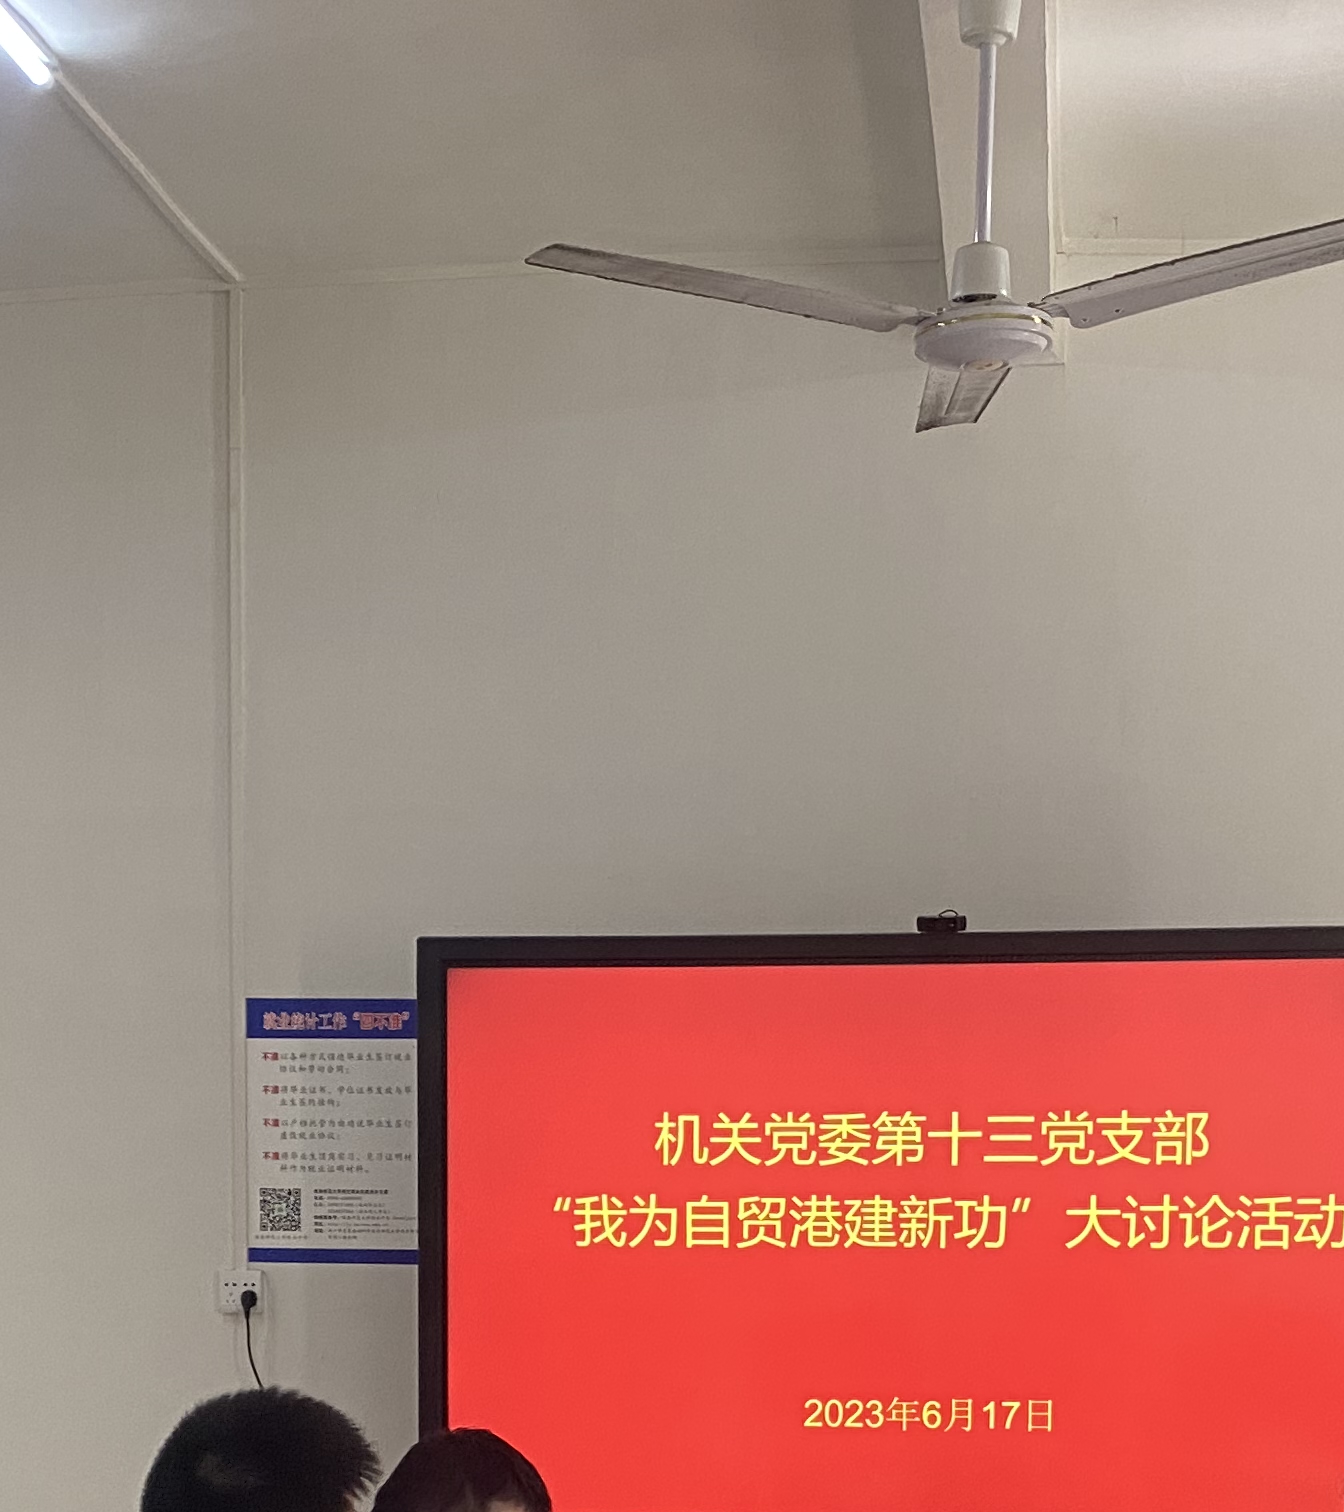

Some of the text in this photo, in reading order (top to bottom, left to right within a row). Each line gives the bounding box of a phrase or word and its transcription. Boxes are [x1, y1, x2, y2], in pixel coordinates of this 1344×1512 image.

[654, 1109, 1210, 1167] 机关党委第十三党支部
[803, 1396, 1053, 1432] 2023年6月17日
